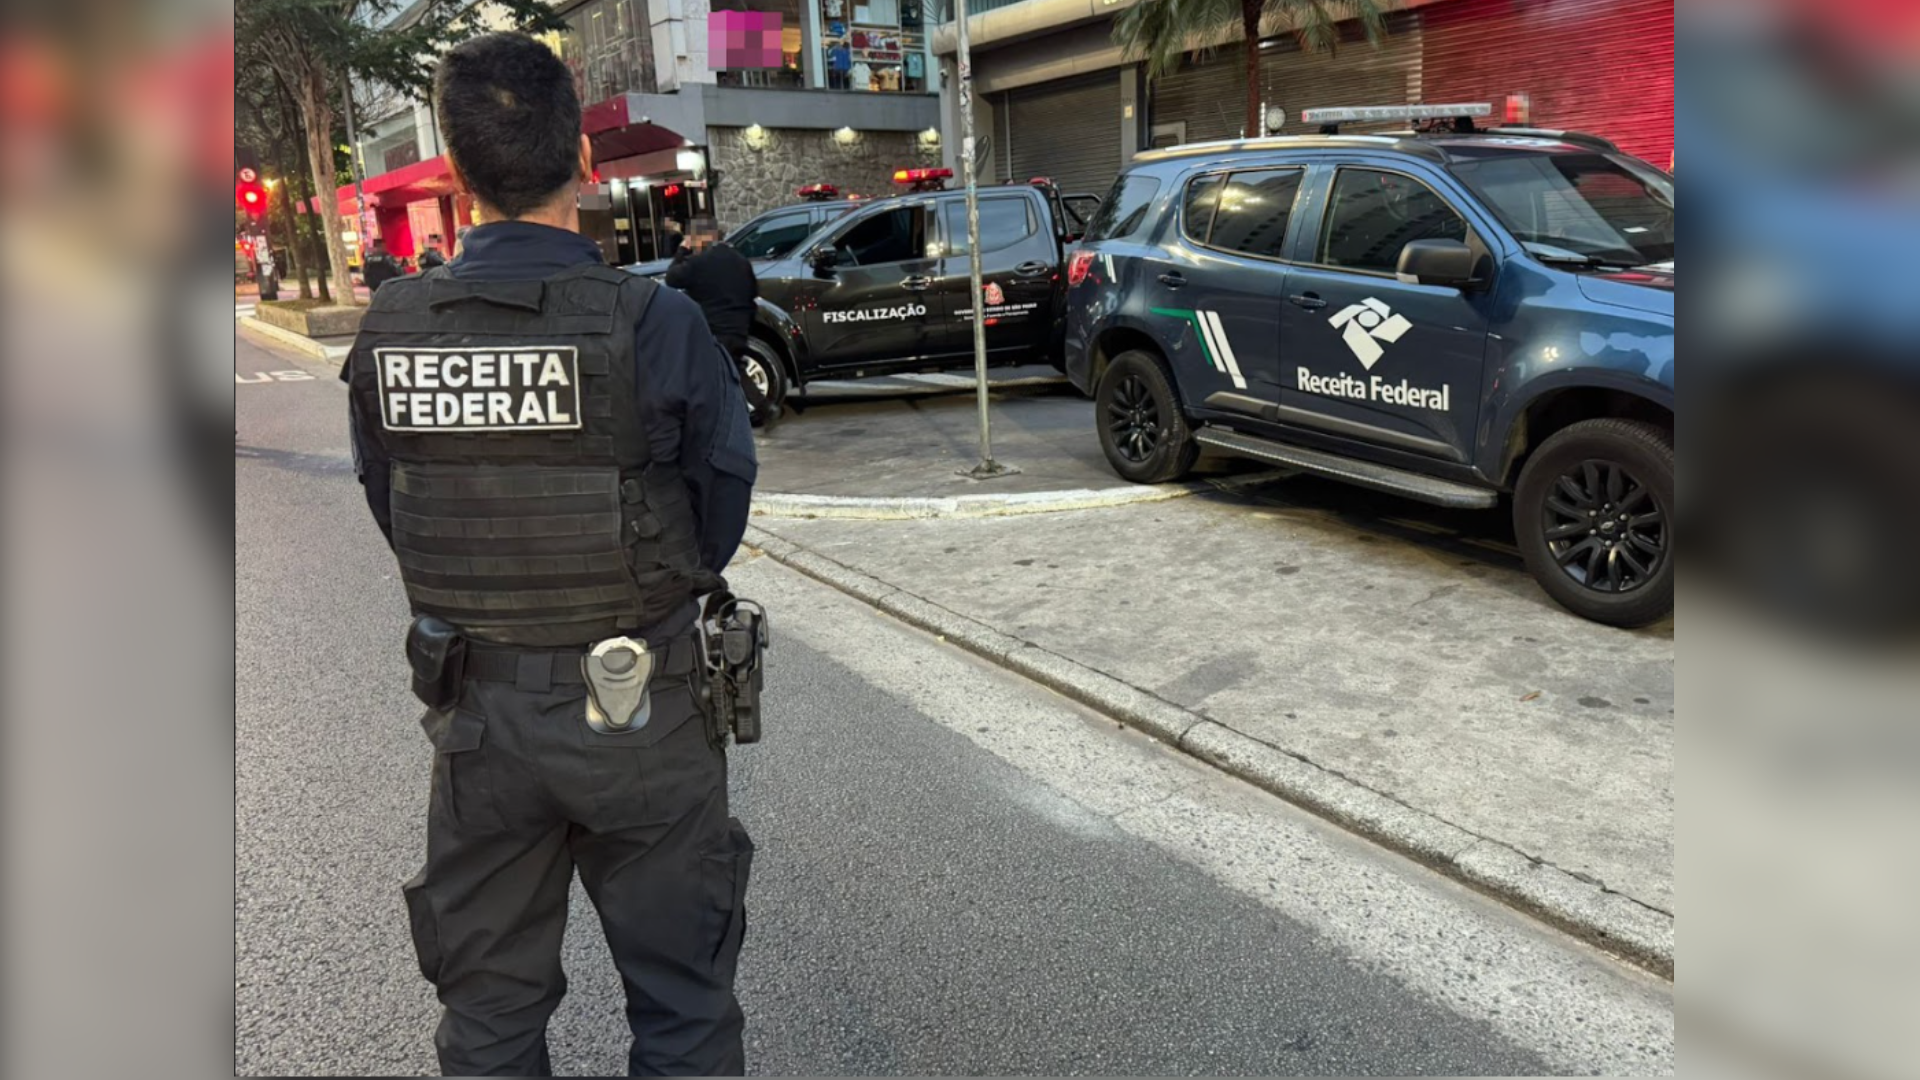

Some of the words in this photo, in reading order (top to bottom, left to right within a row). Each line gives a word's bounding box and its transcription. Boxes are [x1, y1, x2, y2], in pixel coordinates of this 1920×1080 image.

[823, 303, 926, 323] FISCALIZAÇÃO
[384, 353, 571, 388] RECEITA
[1297, 366, 1366, 399] Receita
[1370, 375, 1450, 411] Federal
[388, 390, 571, 426] FEDERAL
